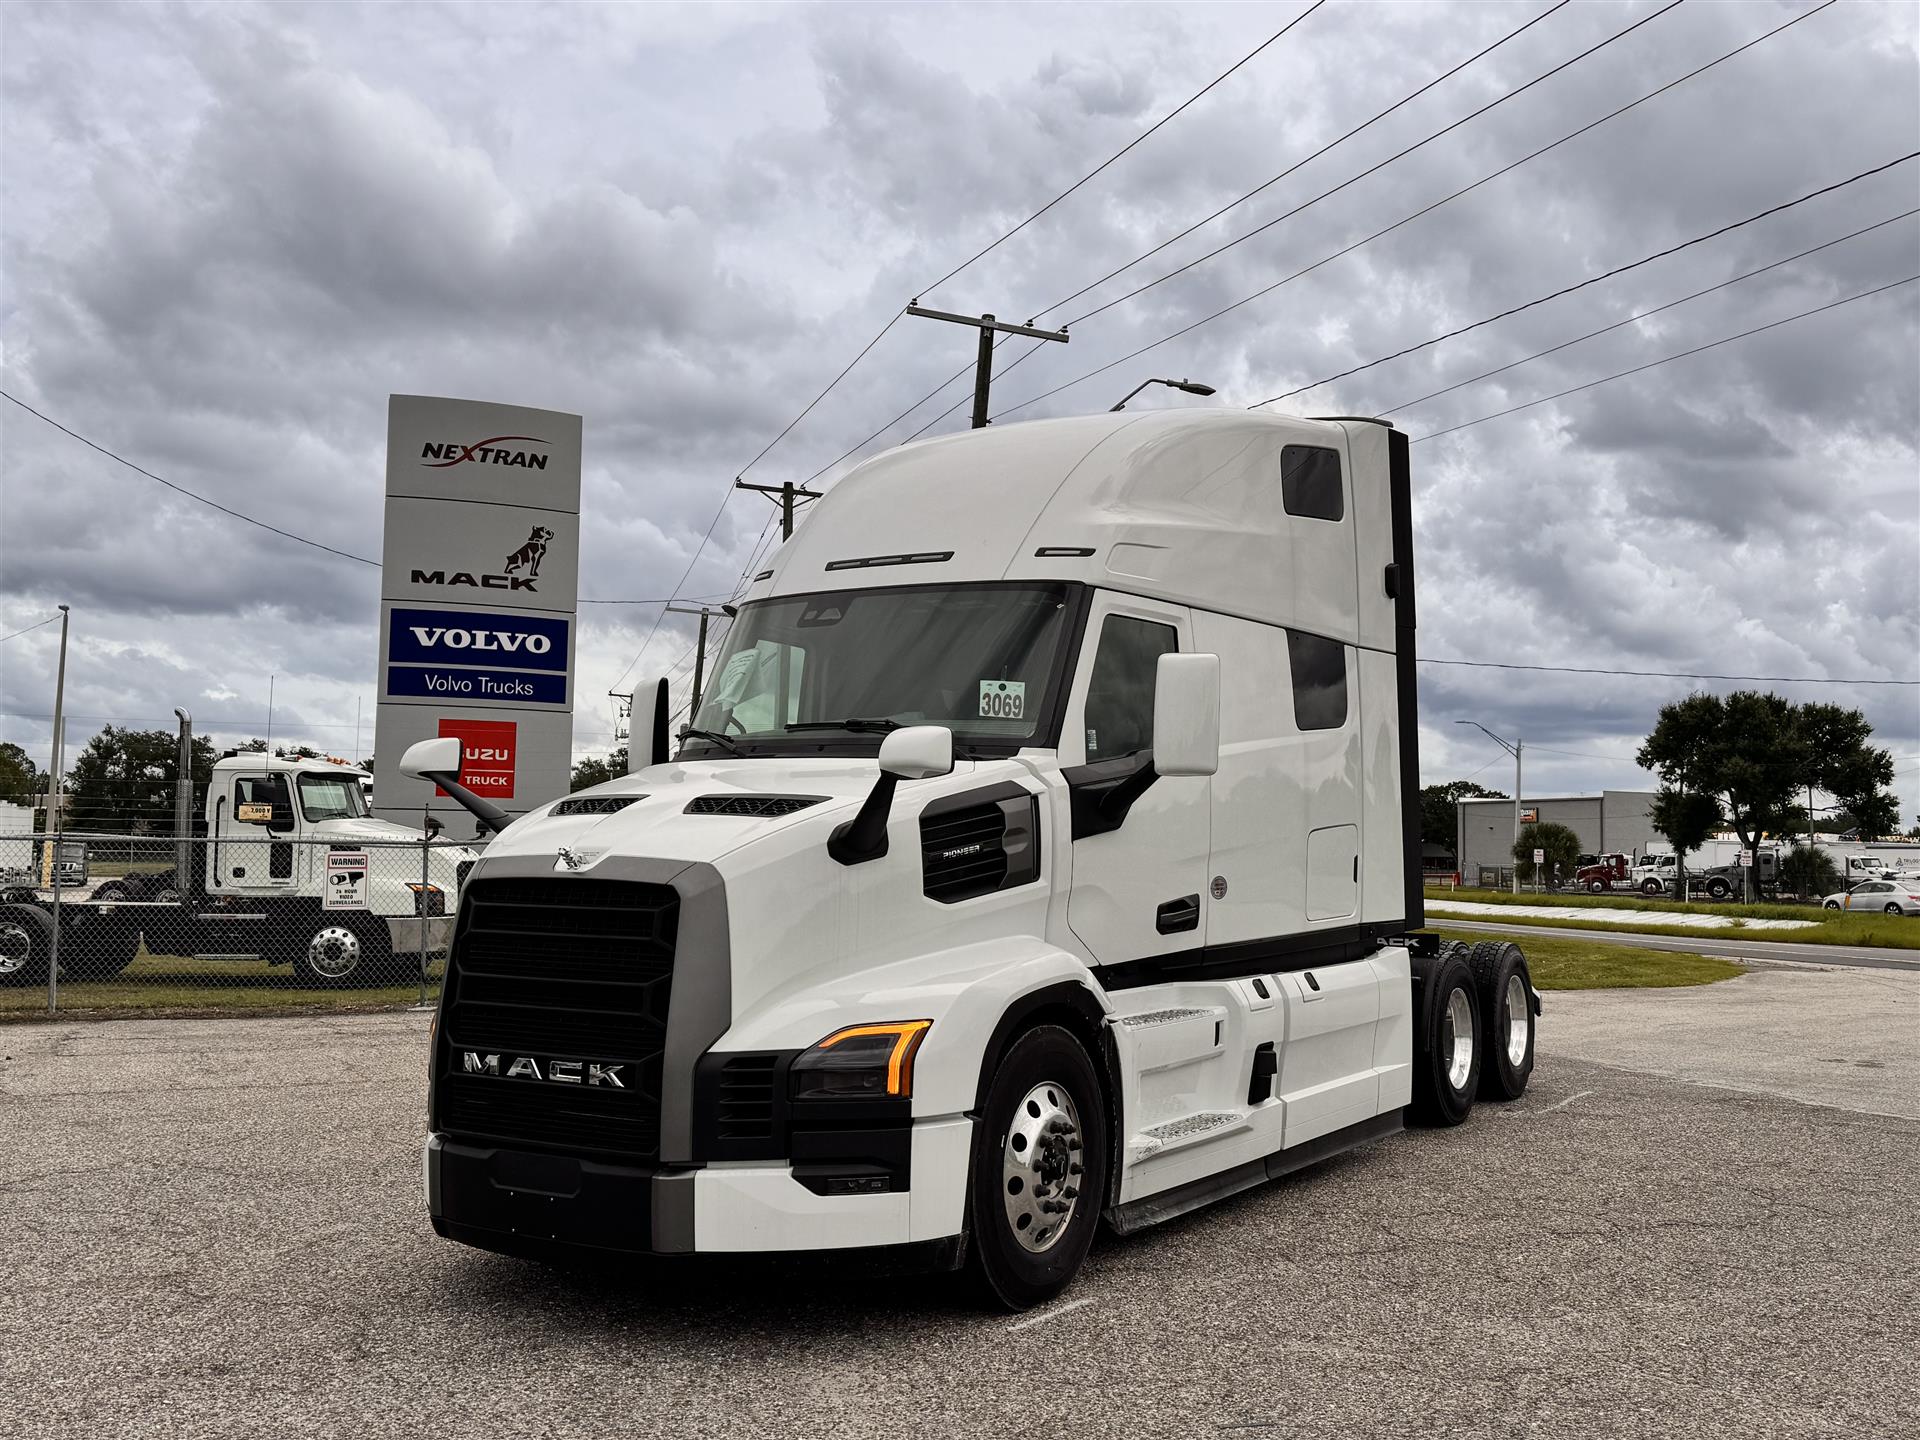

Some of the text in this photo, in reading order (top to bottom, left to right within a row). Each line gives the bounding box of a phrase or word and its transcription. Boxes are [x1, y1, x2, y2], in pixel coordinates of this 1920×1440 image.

[421, 442, 549, 470] NEXTRAN
[410, 569, 538, 593] MACK
[409, 626, 552, 654] VOLVO
[424, 674, 534, 695] Volvo Trucks
[981, 692, 1023, 718] 3069
[462, 747, 509, 761] UZU
[464, 775, 508, 786] TRUCK
[330, 857, 365, 866] WARNING
[1376, 937, 1420, 947] ACK
[463, 1051, 625, 1088] MACK
